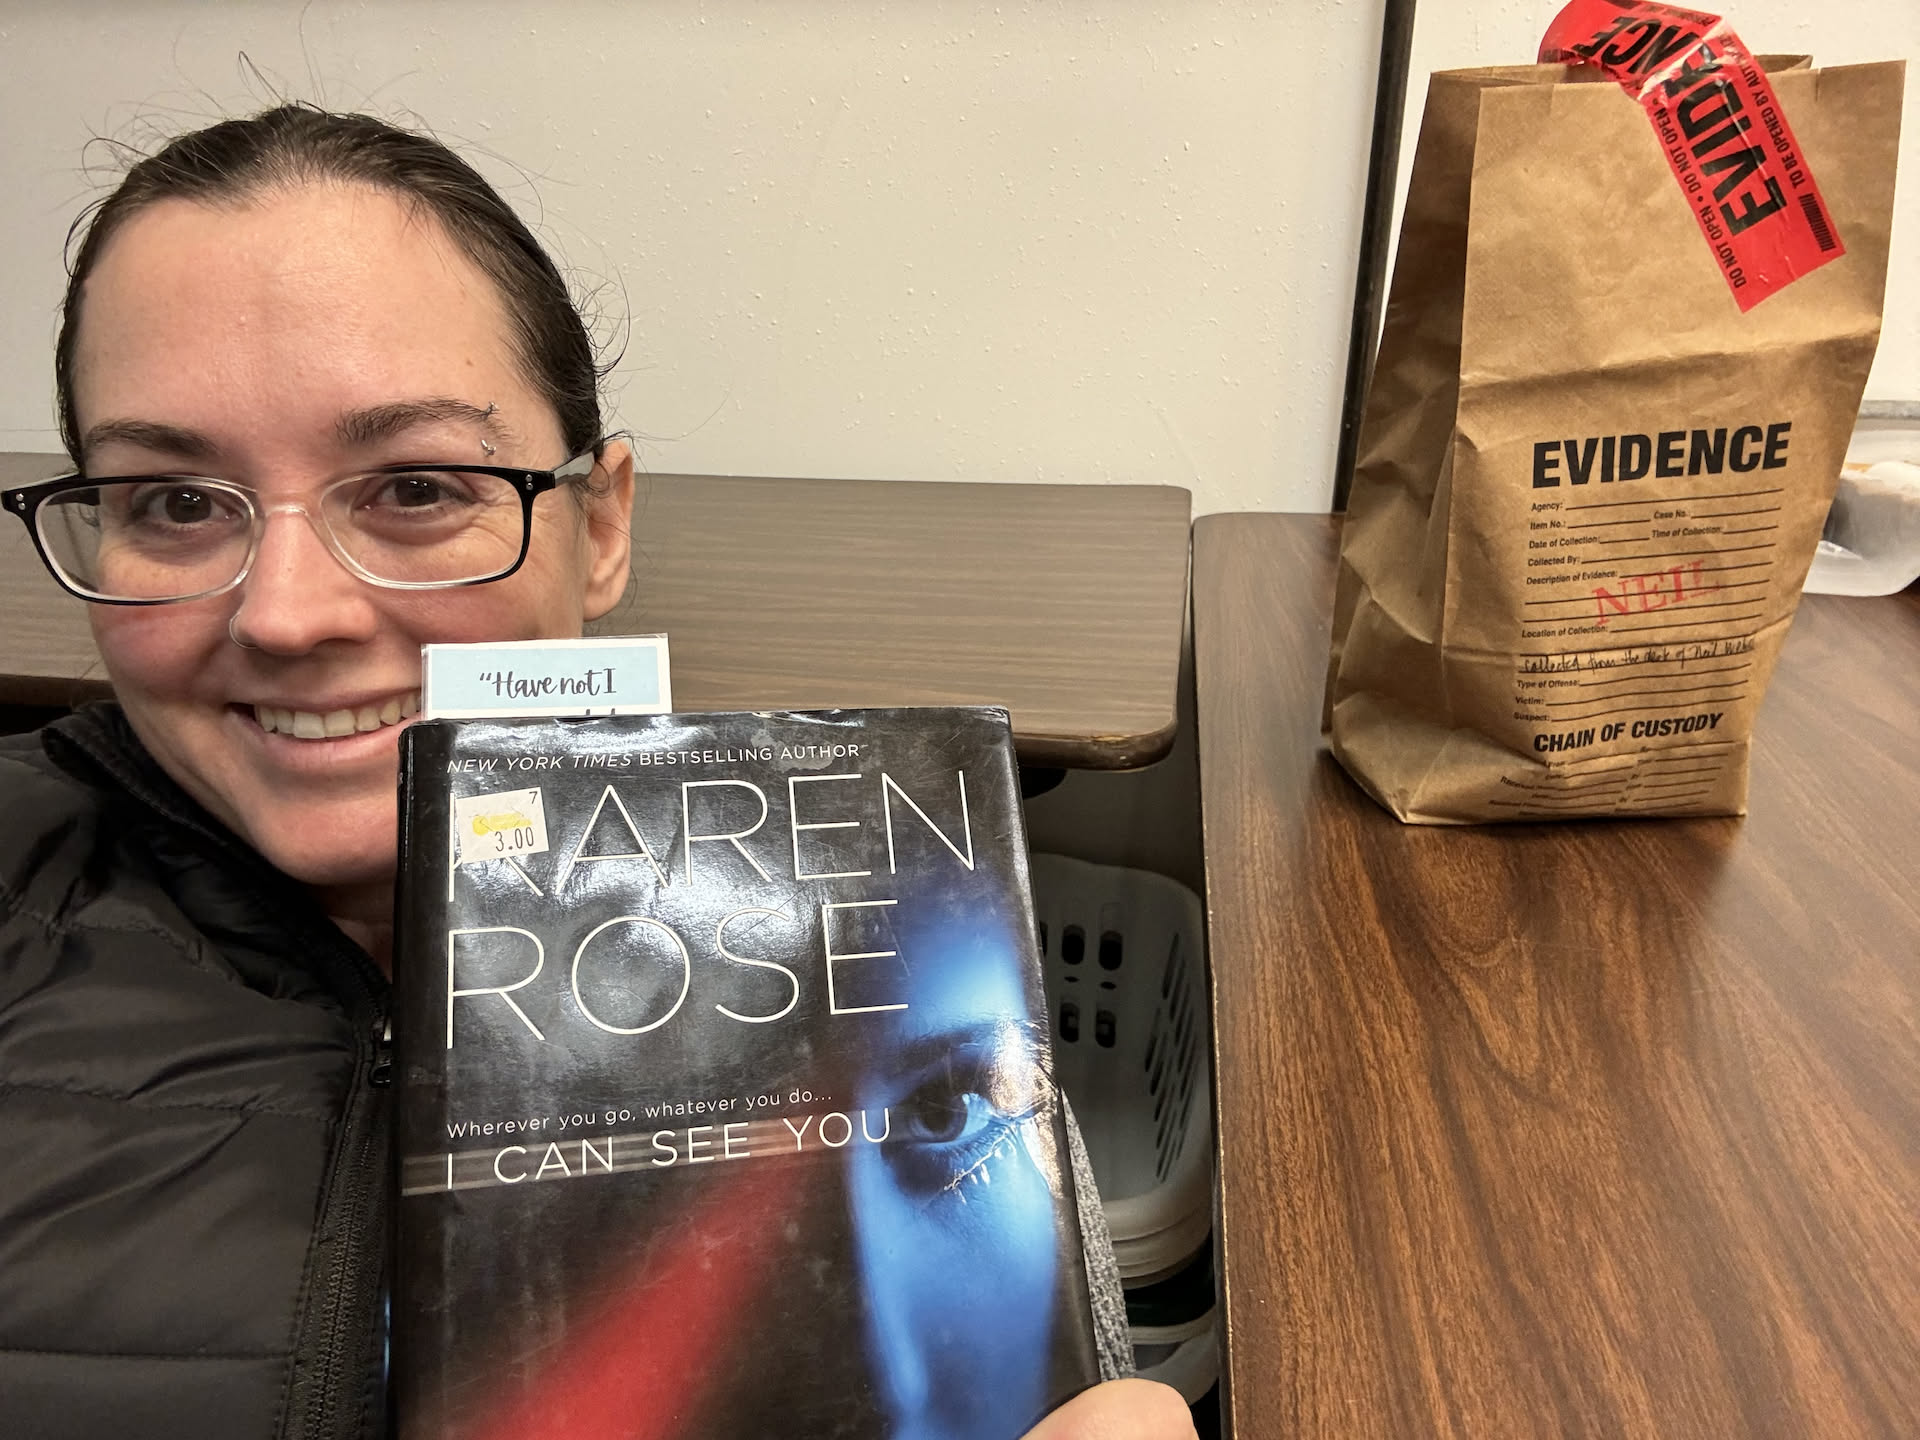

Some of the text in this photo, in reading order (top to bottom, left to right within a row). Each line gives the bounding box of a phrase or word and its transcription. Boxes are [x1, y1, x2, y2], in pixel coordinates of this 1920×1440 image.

[1752, 89, 1769, 106] BY
[1760, 107, 1790, 153] OPENED
[1653, 107, 1702, 193] DO NOT OPEN
[1781, 152, 1798, 171] BE
[1789, 170, 1805, 189] TO
[1699, 205, 1747, 288] DO NOT OPEN
[1532, 422, 1792, 489] EVIDENCE
[1531, 502, 1563, 513] Agency:
[1653, 510, 1674, 520] Case
[1530, 521, 1547, 530] Item
[1651, 529, 1671, 538] Time
[1672, 528, 1681, 537] of
[1529, 535, 1600, 549] Date of Collection:
[1527, 555, 1580, 567] Collected By:
[1526, 570, 1617, 586] Description of Evidence:
[1592, 559, 1721, 627] NEIL
[1522, 624, 1608, 639] Location of Collection:
[560, 669, 602, 696] not
[602, 667, 617, 694] I
[1517, 679, 1580, 689] Type of Offense:
[1515, 696, 1544, 705] Victim:
[1513, 711, 1550, 723] Suspect:
[1534, 712, 1724, 752] CHAIN OF CUSTODY
[447, 744, 860, 774] NEW YORK TIMES BESTSELLING AUTHOR
[528, 791, 538, 804] 7
[494, 826, 534, 852] 3.00
[446, 899, 909, 1050] ROSE
[446, 1087, 832, 1140] Wherever you go, whatever you do...
[446, 1107, 892, 1190] I CAN SEE YOU
